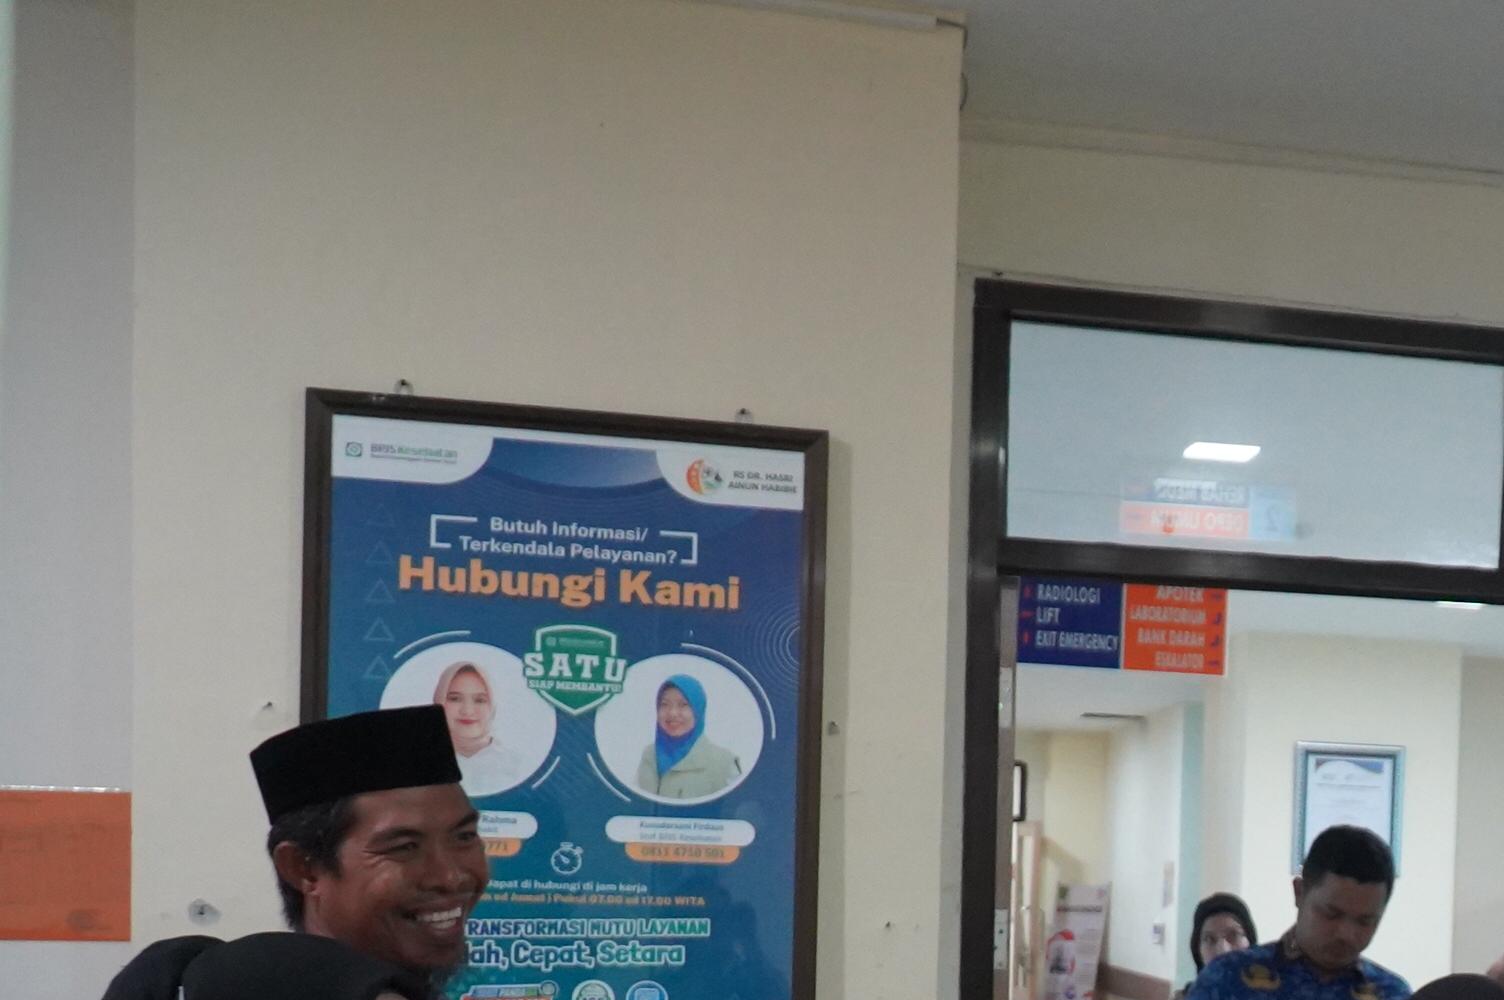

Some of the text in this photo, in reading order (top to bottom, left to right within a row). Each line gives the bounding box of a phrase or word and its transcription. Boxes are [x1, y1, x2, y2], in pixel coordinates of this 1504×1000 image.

[490, 516, 649, 543] Butuh Informasi/
[459, 535, 678, 564] Terkendala Pelayanan?
[399, 554, 741, 611] Hubungi Kami
[1037, 584, 1101, 604] RADIOLOGI
[1036, 607, 1060, 624] LIFT
[1036, 630, 1119, 651] EXIT EMERGENCY
[524, 652, 627, 682] SATU
[521, 880, 532, 889] di
[534, 880, 580, 891] hubungi
[582, 882, 593, 890] di
[619, 883, 648, 893] kerja
[674, 896, 706, 906] WITA
[466, 918, 711, 937] RANSFORMASI MUTU LAYANAN
[511, 941, 595, 972] Cepat,
[597, 941, 686, 966] Setara
